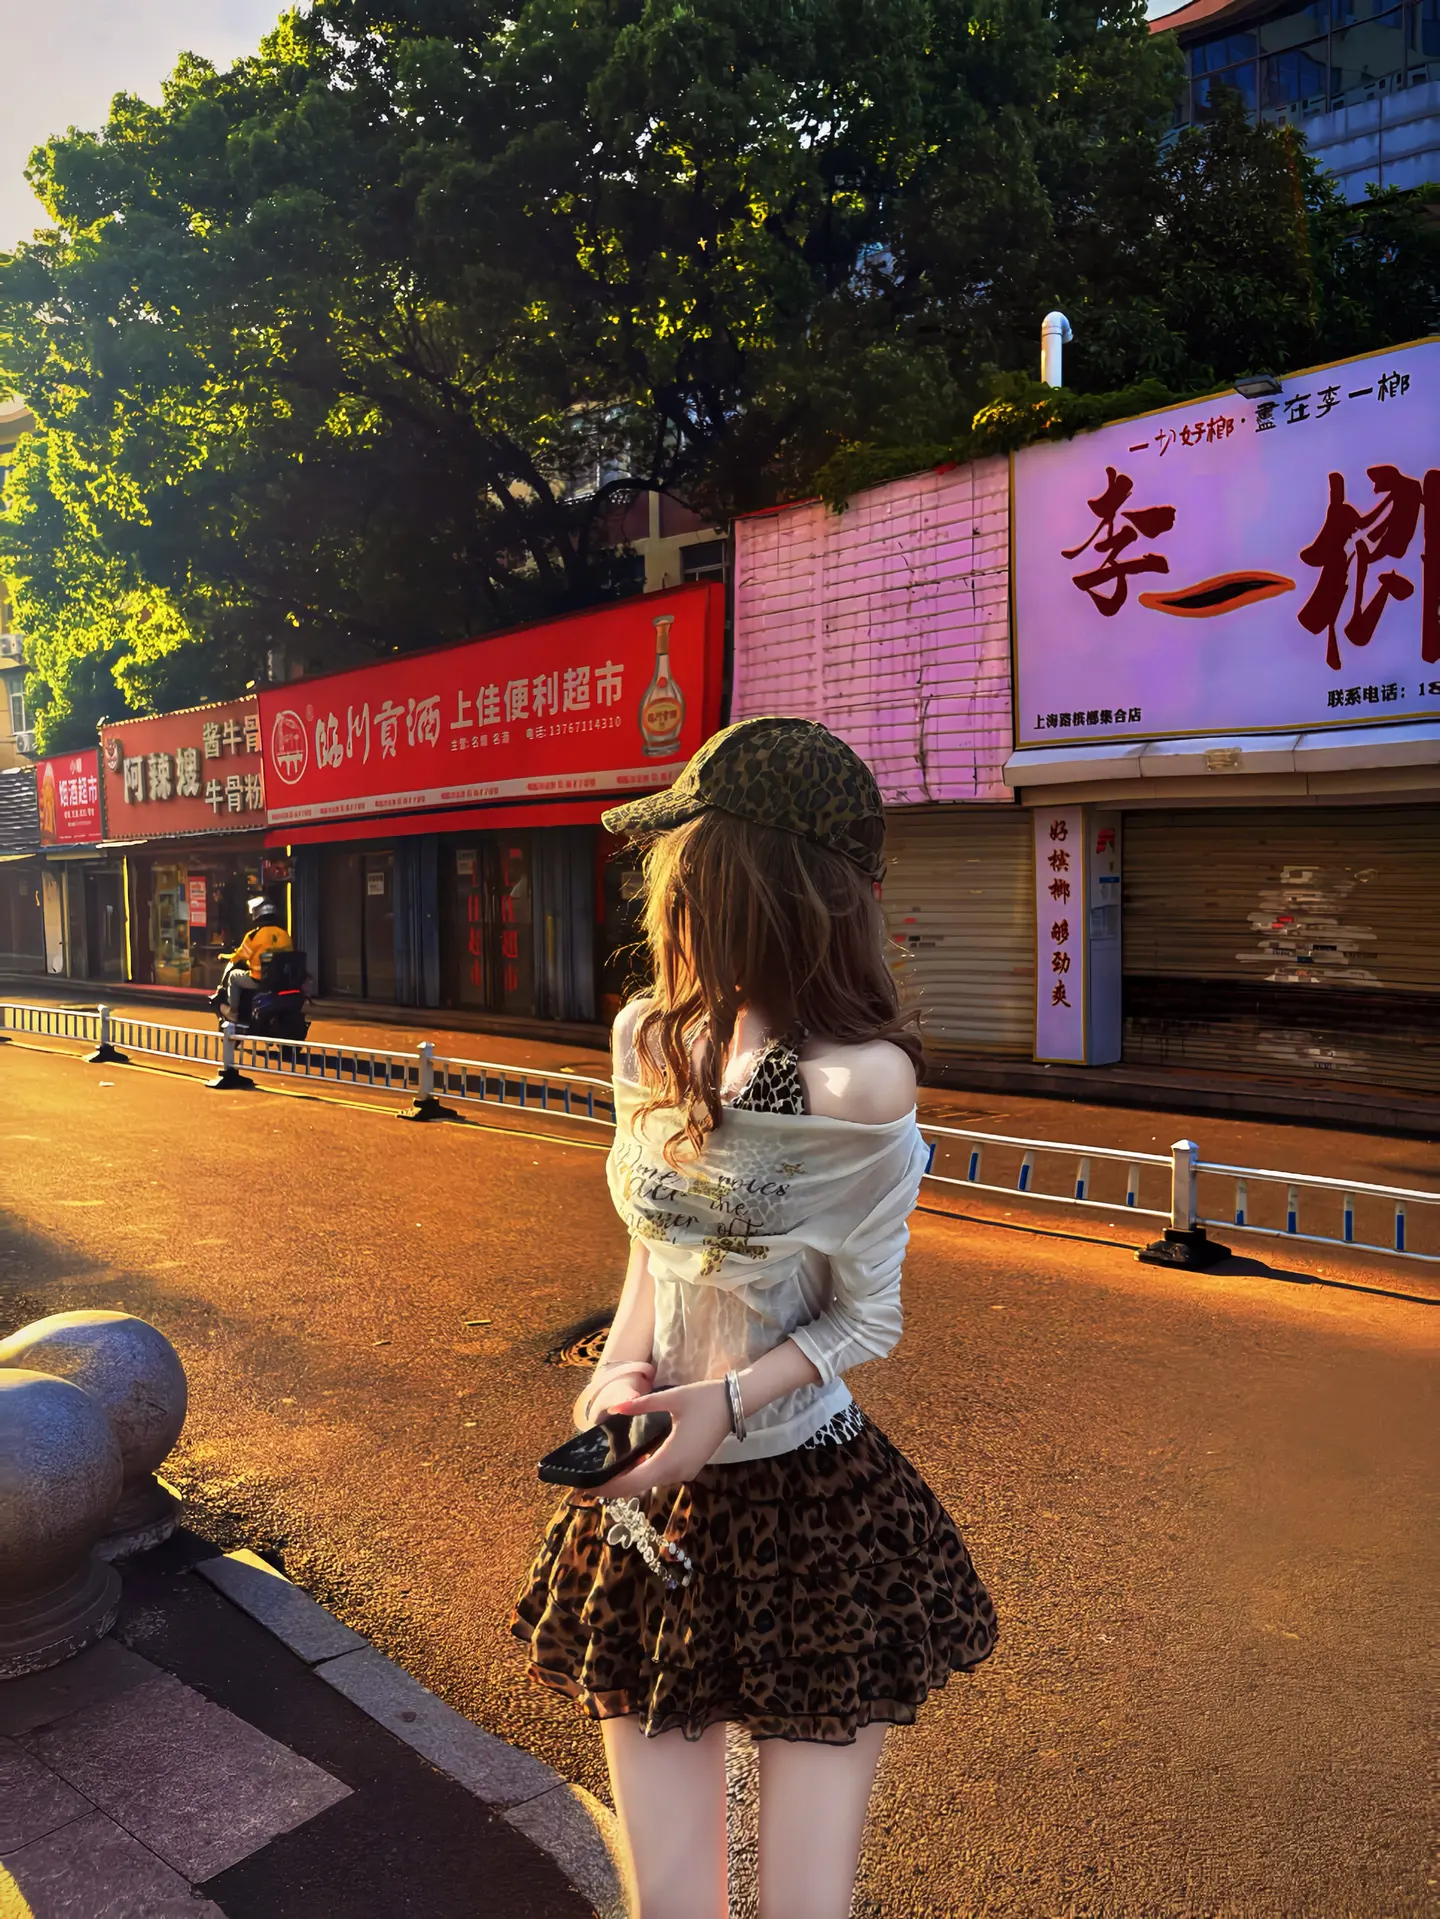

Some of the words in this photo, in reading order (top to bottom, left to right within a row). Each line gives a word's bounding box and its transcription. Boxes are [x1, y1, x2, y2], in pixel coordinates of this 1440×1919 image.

[450, 659, 624, 730] 上佳便利超市
[1033, 707, 1142, 730] 上海路槟榔集合店
[203, 714, 262, 760] 酱牛骨
[123, 747, 200, 804] 阿辣嫂
[204, 773, 264, 814] 牛骨粉
[1050, 918, 1072, 1008] 够劲爽
